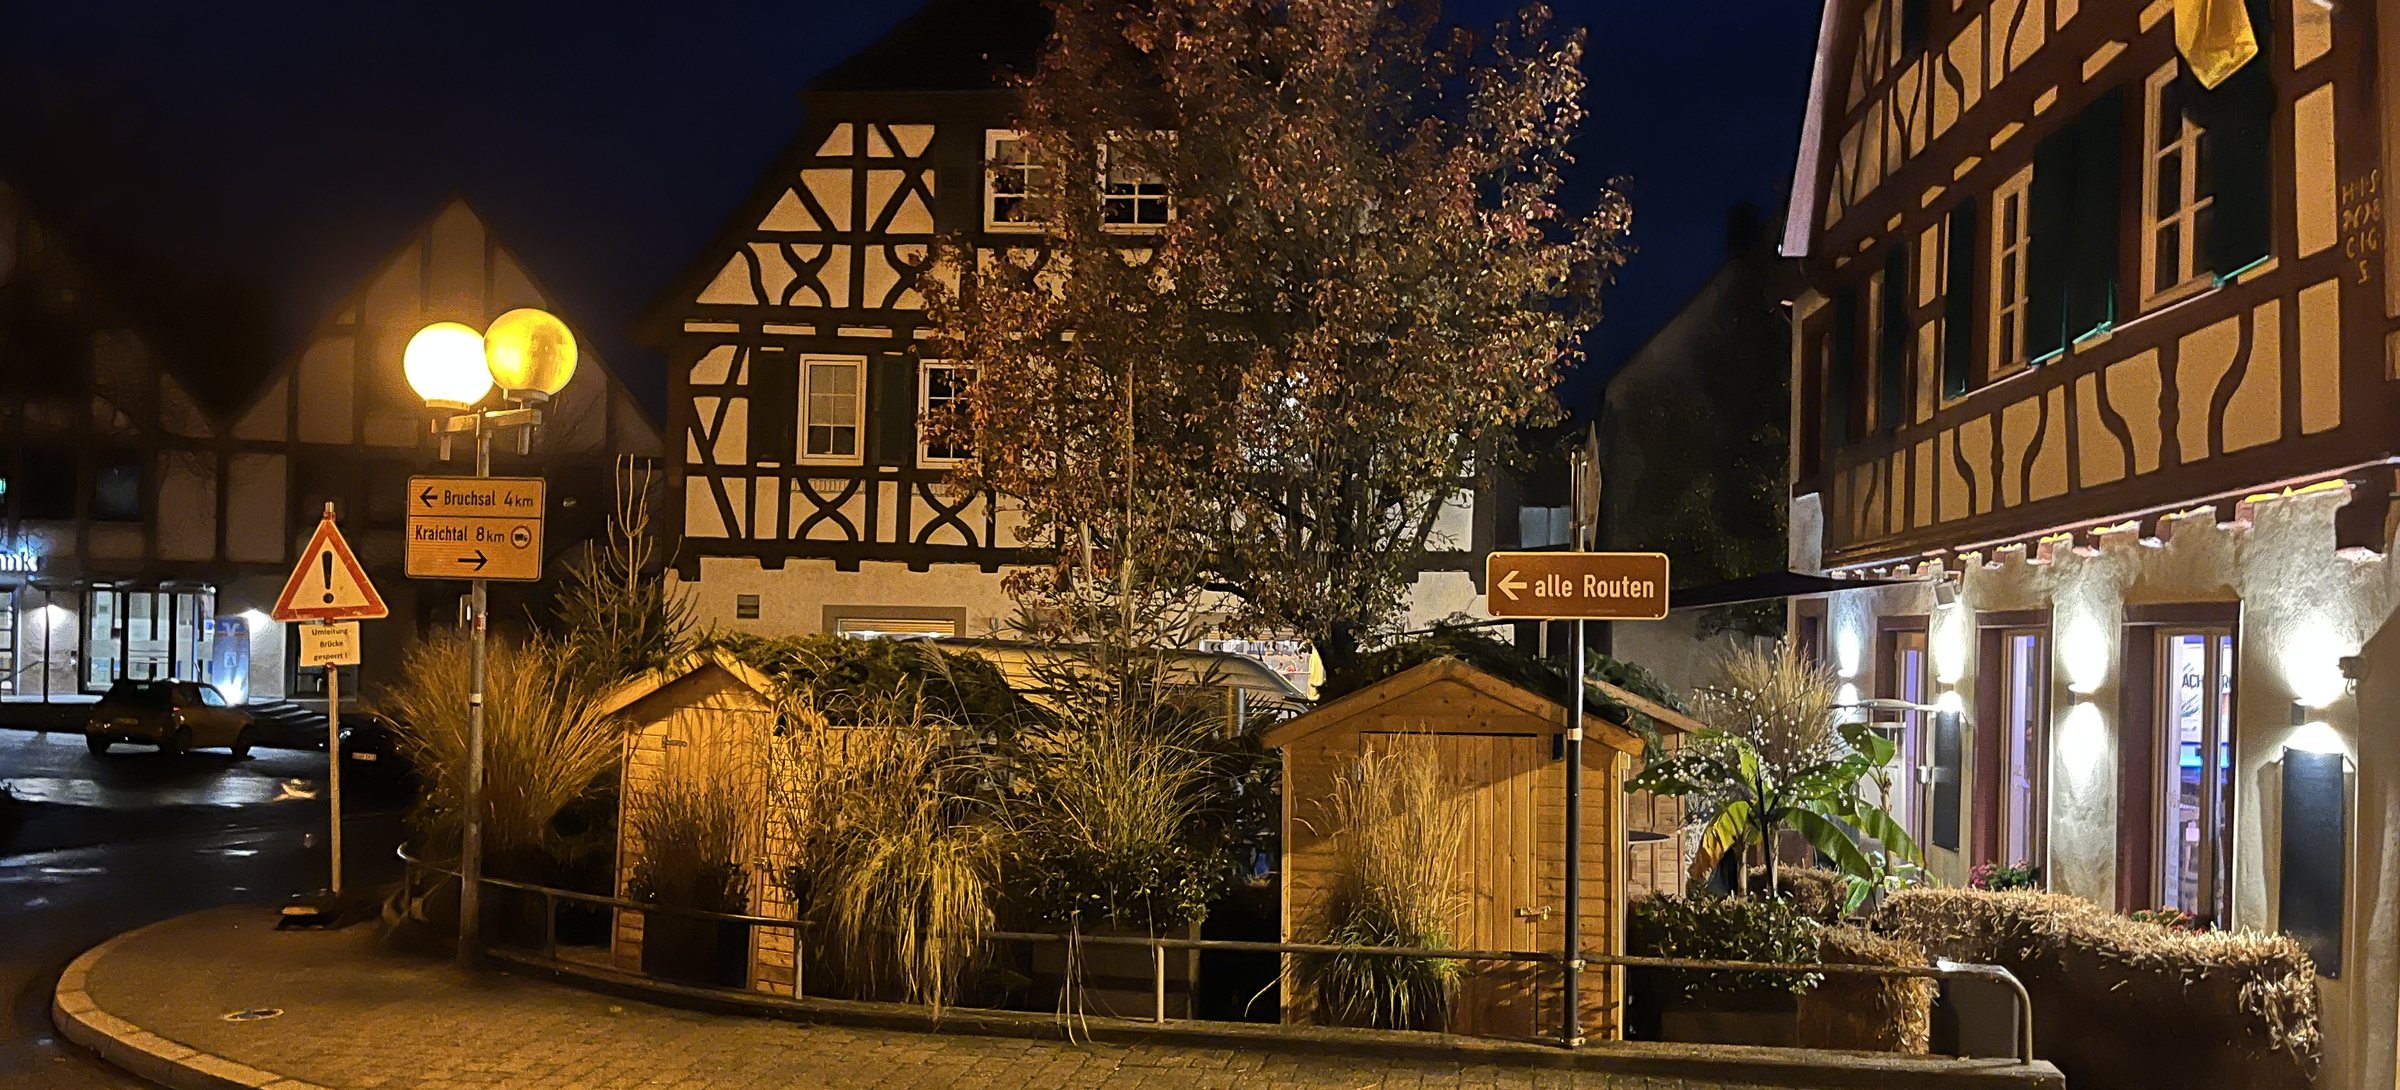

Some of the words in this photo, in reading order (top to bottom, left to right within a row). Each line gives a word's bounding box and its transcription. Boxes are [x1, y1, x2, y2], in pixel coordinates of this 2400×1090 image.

[444, 489, 496, 506] Bruchsal
[415, 524, 468, 541] Kraichtal
[1535, 574, 1573, 598] alle
[1583, 574, 1654, 598] Routen
